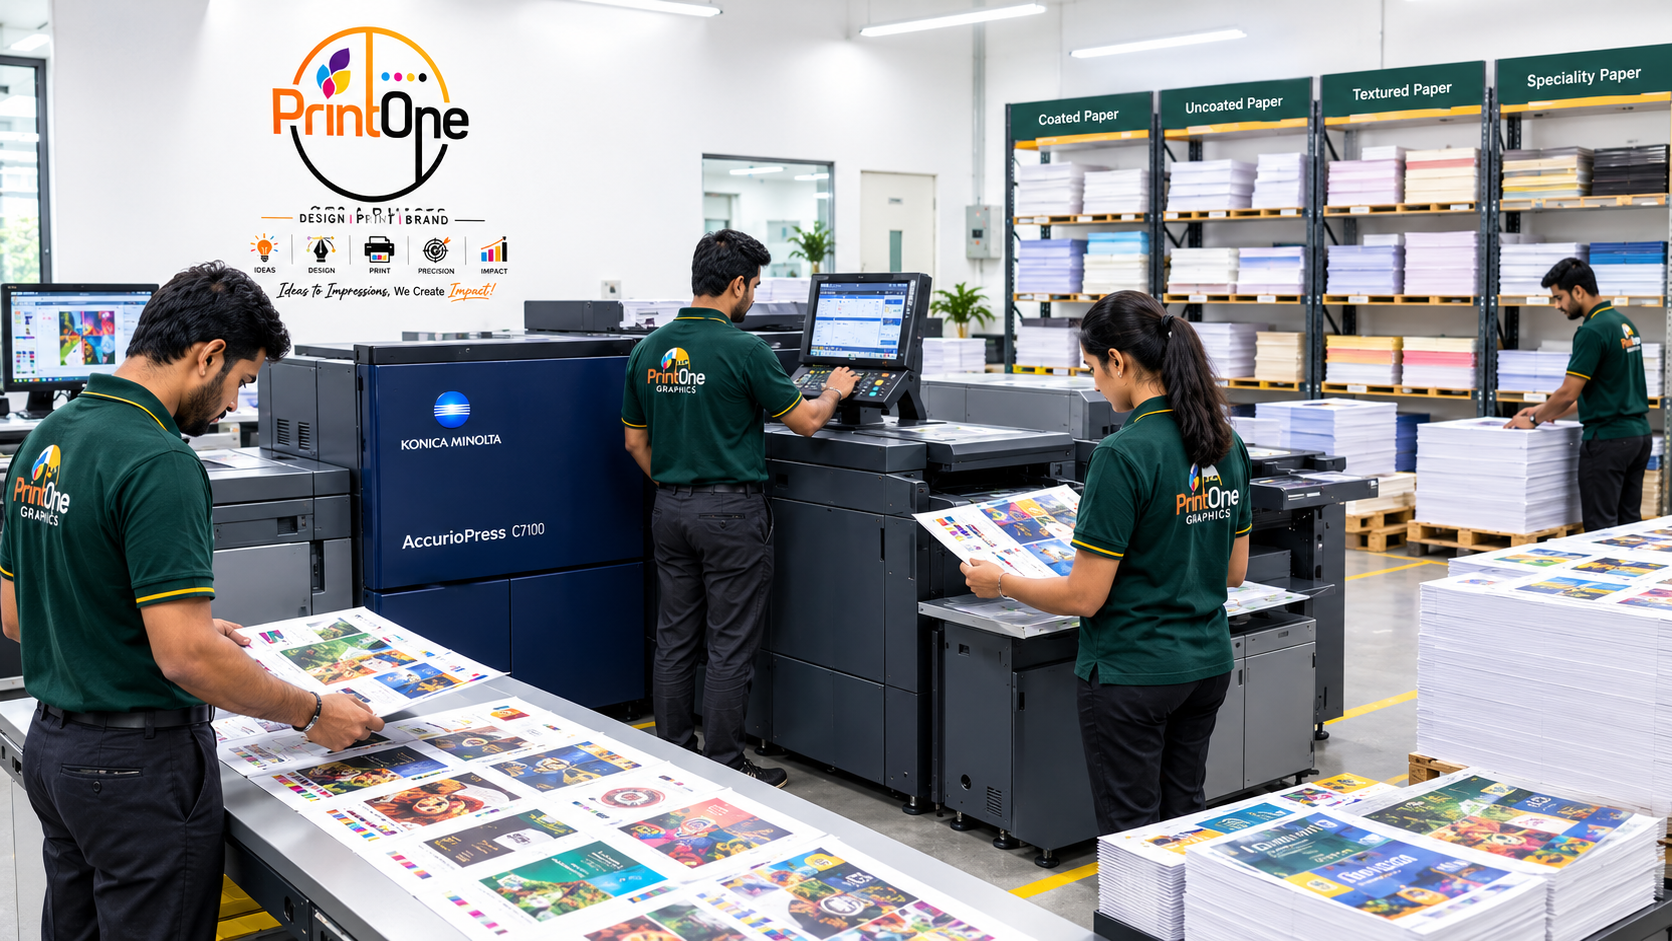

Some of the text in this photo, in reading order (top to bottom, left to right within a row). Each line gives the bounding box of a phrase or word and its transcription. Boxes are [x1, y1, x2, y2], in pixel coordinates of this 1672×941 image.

[1527, 67, 1642, 90] Speciality Paper
[1352, 82, 1453, 101] Textured Paper
[272, 87, 470, 140] PrintOne
[1185, 96, 1284, 115] Uncoated Paper
[1038, 109, 1119, 126] Coated Paper
[299, 213, 345, 224] DESIGN
[405, 214, 449, 225] BRAND
[253, 266, 276, 275] IDEAS
[307, 267, 336, 275] DESIGN
[368, 267, 391, 275] PRINT
[417, 267, 456, 275] PRECISION
[480, 267, 508, 275] IMPACT
[276, 282, 496, 303] Ideas to Impressions, We Create Impact!
[647, 367, 706, 386] PrintOne
[656, 385, 697, 395] GRAPHICS
[400, 434, 502, 451] KONICA MINOLTA
[13, 476, 70, 514] PrintOne
[1176, 486, 1239, 515] PrintOne
[20, 505, 59, 526] GRAPHICS
[1185, 508, 1231, 525] GRAPHICS
[402, 522, 545, 550] AccurioPress C7100
